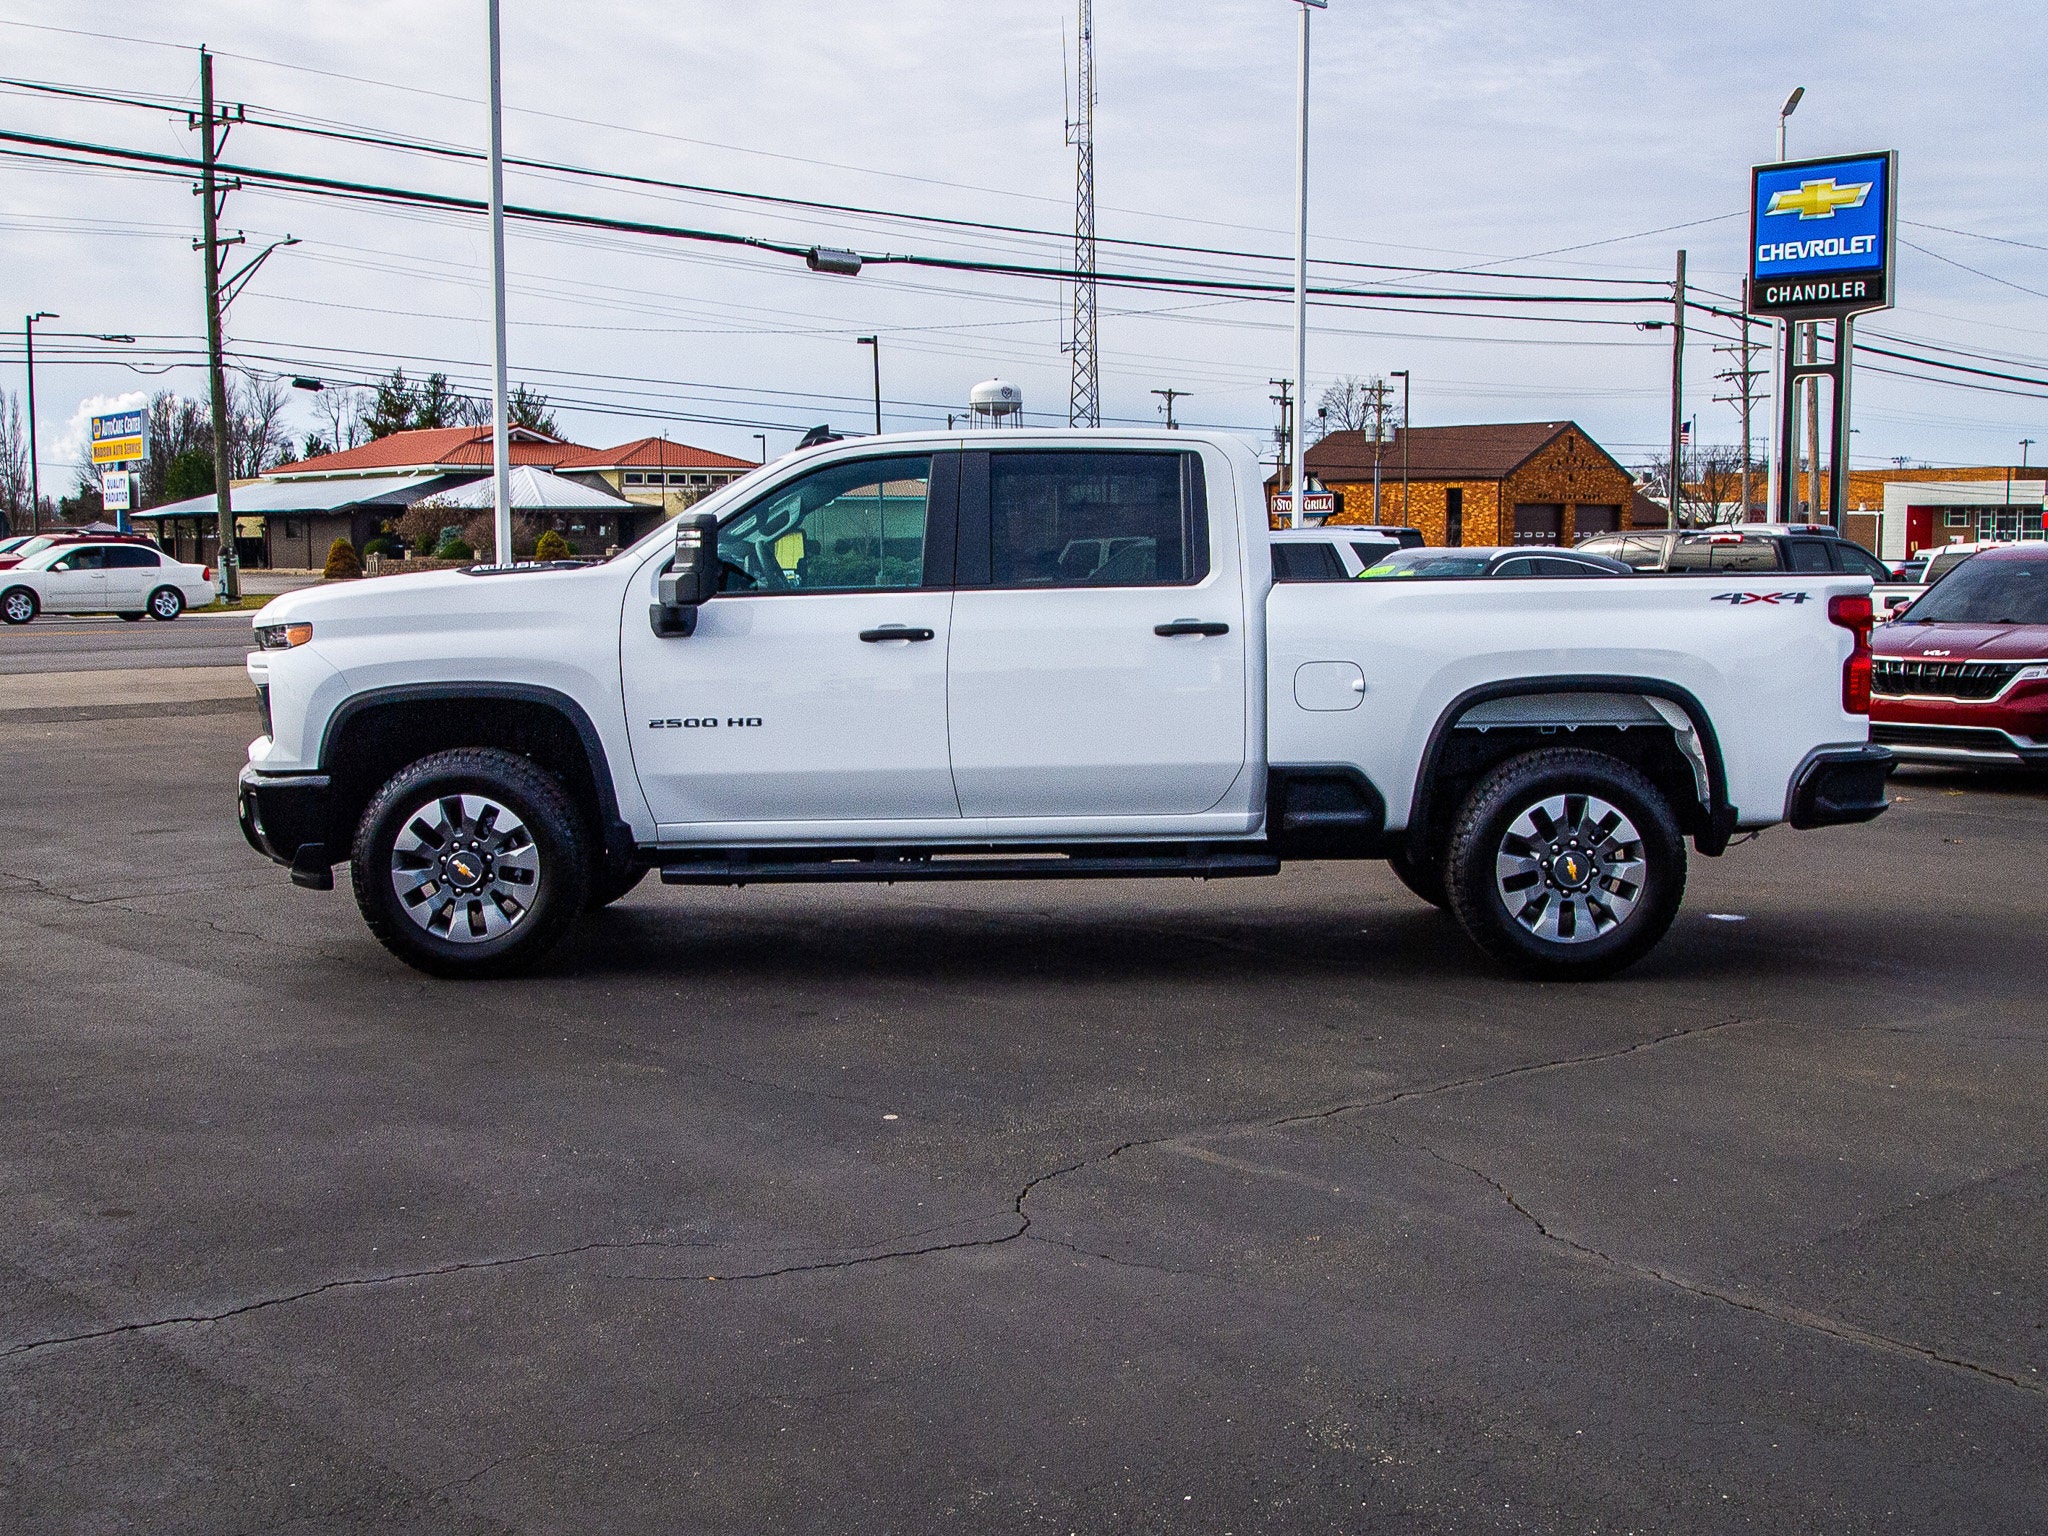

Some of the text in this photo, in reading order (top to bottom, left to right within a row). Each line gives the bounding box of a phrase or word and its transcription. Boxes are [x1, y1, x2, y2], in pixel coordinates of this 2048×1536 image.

[1758, 234, 1876, 262] CHEVROLET
[1766, 281, 1866, 303] CHANDLER
[106, 478, 126, 489] QUALITY
[105, 491, 128, 503] RADIATOR
[1304, 498, 1329, 511] GRILL
[1710, 592, 1811, 604] 4X4
[648, 717, 762, 729] 2500 HD
